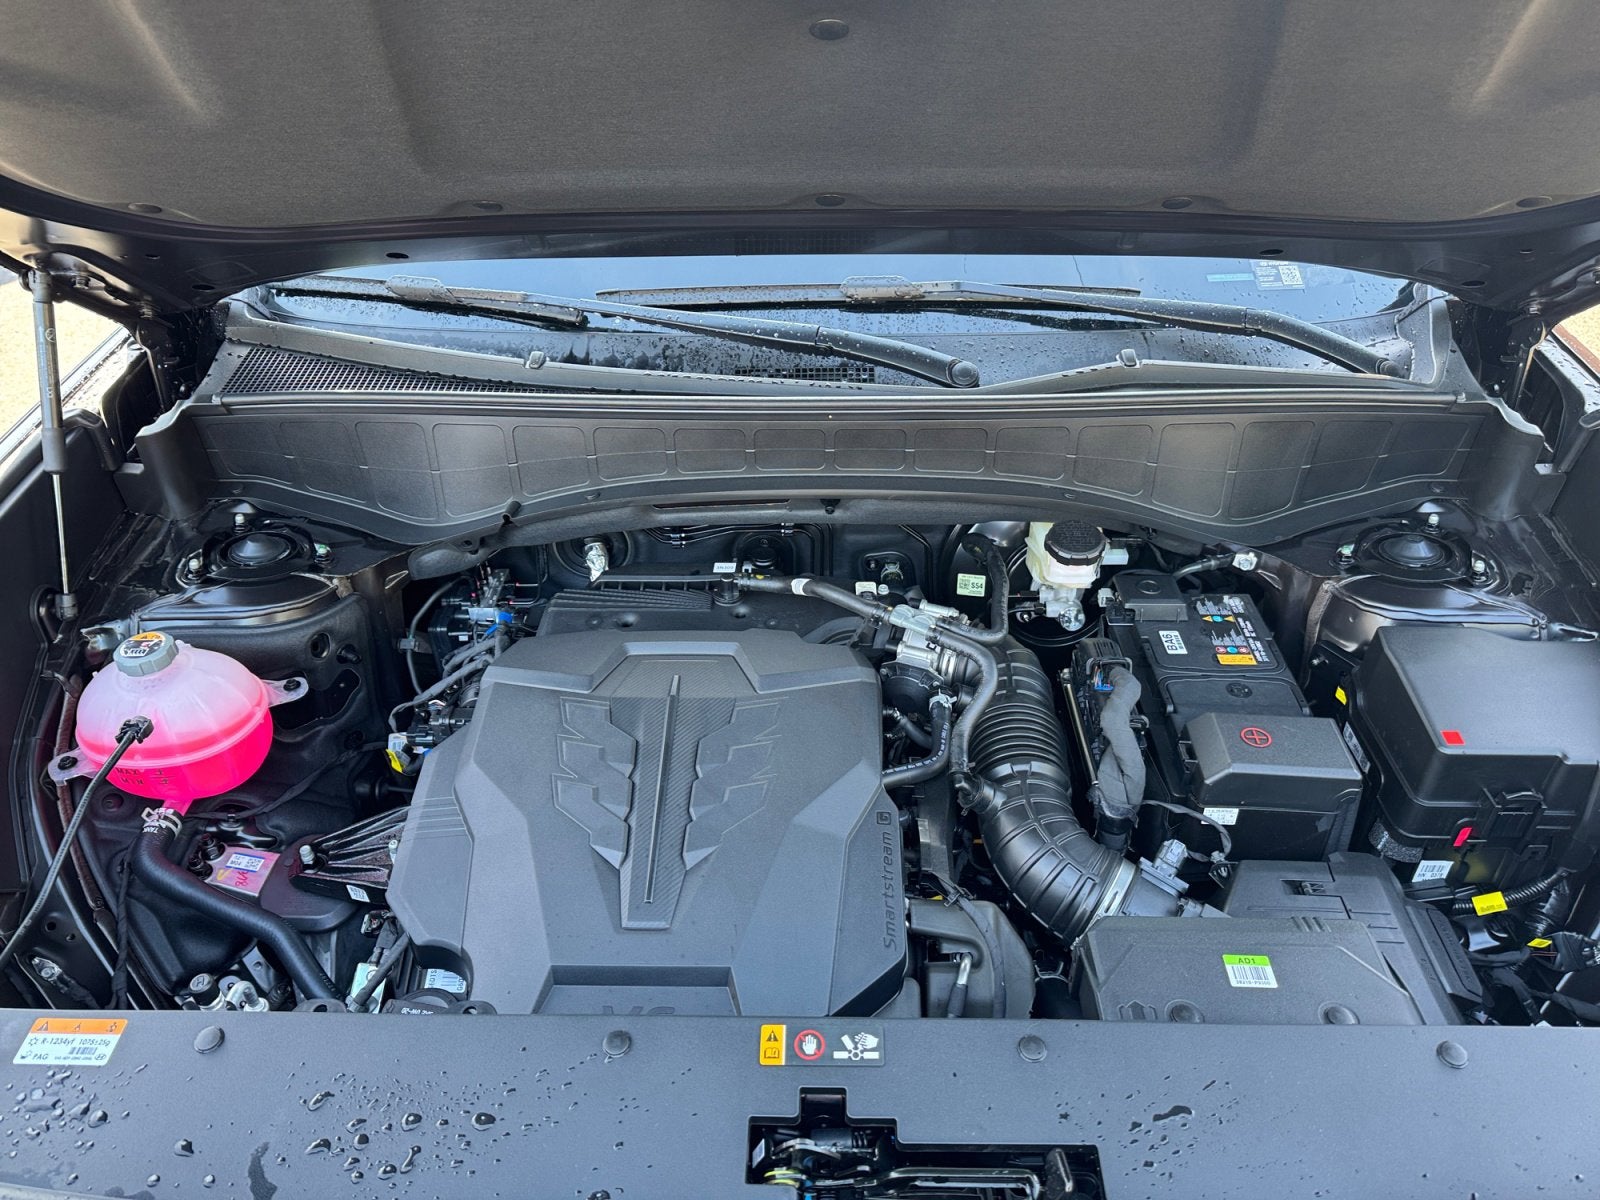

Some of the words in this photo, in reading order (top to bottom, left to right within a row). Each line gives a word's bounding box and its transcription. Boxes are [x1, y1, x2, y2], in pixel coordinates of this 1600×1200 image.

[1162, 633, 1178, 651] BA6
[881, 831, 897, 951] Smartstream
[1238, 957, 1256, 965] AD1
